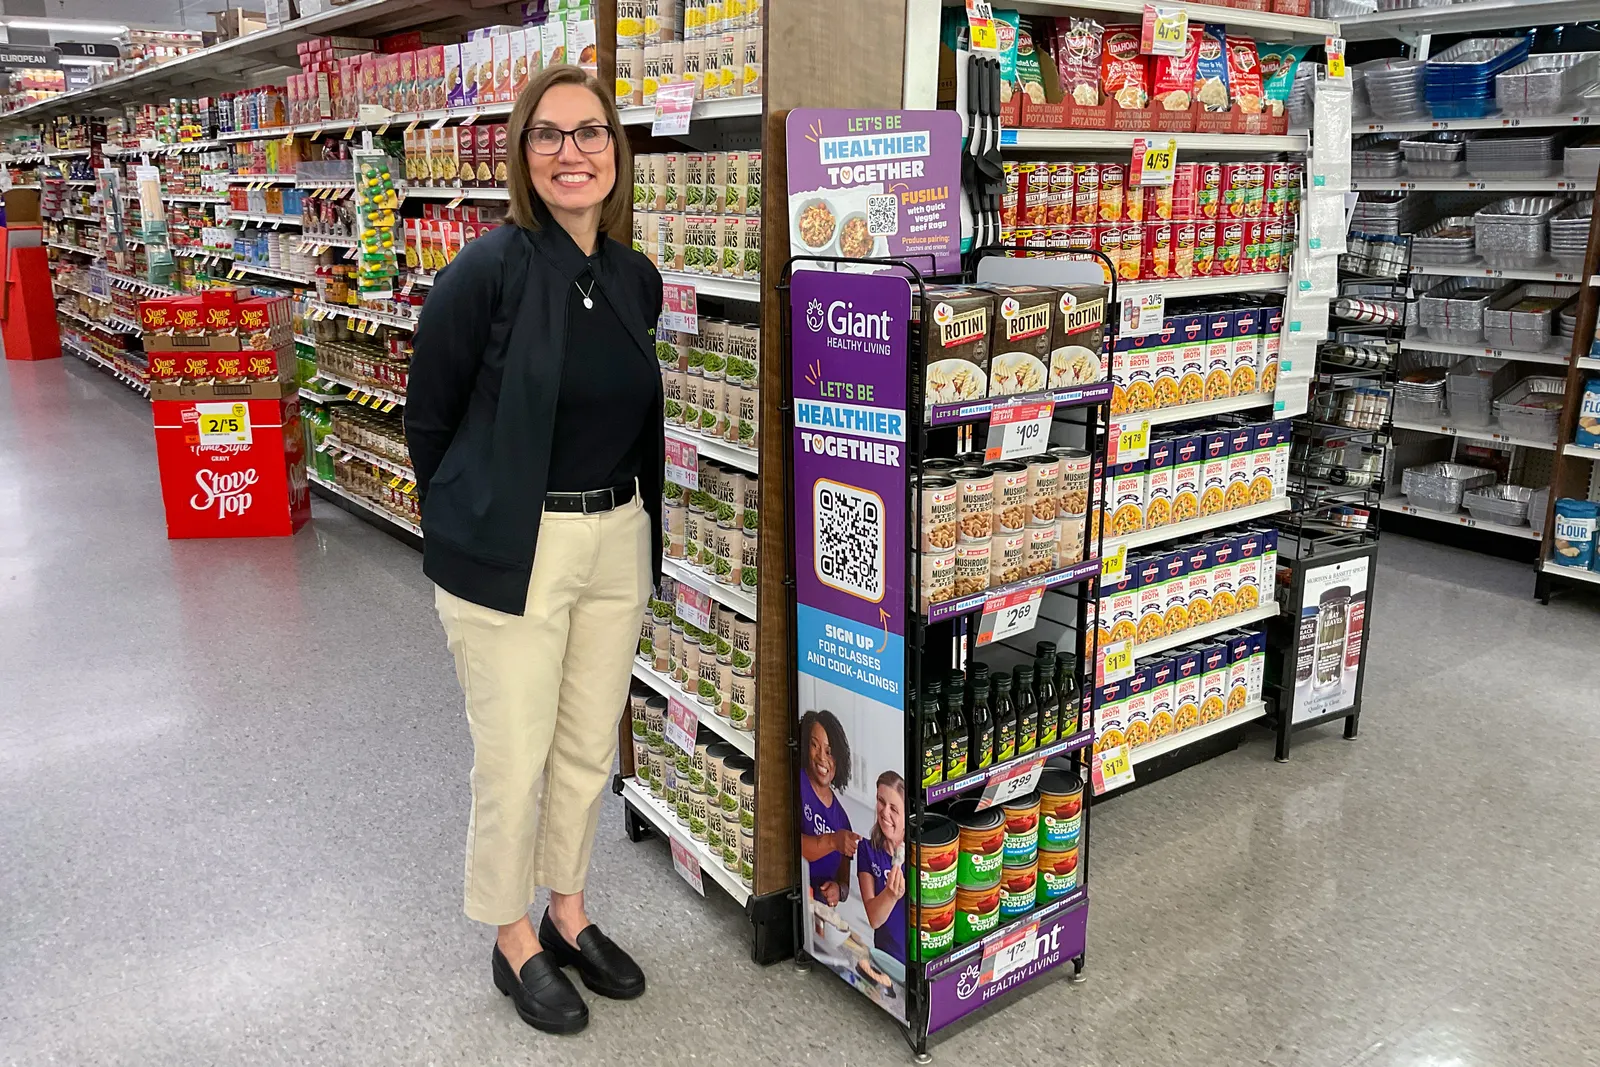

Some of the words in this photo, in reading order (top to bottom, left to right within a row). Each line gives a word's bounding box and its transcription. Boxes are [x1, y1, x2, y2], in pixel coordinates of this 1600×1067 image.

[81, 44, 96, 55] 10
[1110, 42, 1138, 53] IDAHOAN
[1, 54, 47, 64] EUROPEAN
[1027, 105, 1043, 113] 100%
[1071, 108, 1087, 116] 100%
[848, 116, 883, 132] LET'S
[885, 115, 902, 130] BE
[1026, 113, 1063, 123] POTATOES
[1071, 116, 1106, 126] POTATOES
[1114, 119, 1151, 128] POTATOES
[1158, 120, 1191, 129] POTATOES
[1199, 121, 1232, 129] POTATOES
[823, 135, 927, 160] HEALTHIER
[1146, 153, 1170, 170] 4/$5
[828, 160, 925, 186] TOGETHER
[901, 186, 949, 206] FUSILLI
[907, 205, 925, 216] with
[925, 202, 946, 213] Quick
[914, 213, 940, 223] Veggie
[910, 223, 927, 233] Beef
[928, 220, 947, 230] Ragu
[902, 236, 927, 244] Produce
[927, 235, 950, 244] pairing:
[827, 300, 891, 341] Giant
[1068, 305, 1101, 328] ROTINI
[945, 315, 983, 341] ROTINI
[1010, 310, 1047, 335] ROTINI
[705, 339, 724, 353] EANS
[826, 336, 862, 352] HEALTHY
[863, 340, 891, 356] LIVING
[1235, 345, 1253, 353] BROTH
[1183, 351, 1201, 360] BROTH
[1209, 348, 1227, 356] BROTH
[1129, 359, 1150, 367] BROTH
[1156, 355, 1175, 364] BROTH
[819, 380, 854, 400] LET'S
[857, 384, 875, 402] BE
[1083, 388, 1109, 397] TOGETHER
[952, 408, 959, 417] BE
[961, 403, 992, 415] HEALTHIER
[1583, 400, 1600, 415] FLO
[797, 403, 902, 436] HEALTHIER
[1123, 433, 1142, 450] $179
[801, 432, 900, 467] TOGETHER
[1230, 461, 1247, 470] BROTH
[1254, 456, 1271, 465] BROTH
[1177, 471, 1195, 480] BROTH
[1206, 466, 1223, 475] BROTH
[1151, 476, 1168, 485] BROTH
[190, 468, 259, 511] Stove
[1118, 483, 1138, 492] BROTH
[216, 491, 252, 520] Top
[1556, 522, 1587, 538] FLOUR
[1046, 571, 1073, 584] HEALTHIER
[1074, 564, 1099, 576] TOGETHER
[1239, 566, 1256, 575] BROTH
[1306, 575, 1328, 585] MORTON
[1333, 569, 1352, 578] BASSETT
[1352, 565, 1366, 574] SPICES
[1214, 572, 1232, 581] BROTH
[1189, 578, 1208, 587] BROTH
[1166, 585, 1184, 595] BROTH
[1141, 592, 1160, 602] BROTH
[948, 605, 956, 613] BE
[1113, 599, 1133, 609] BROTH
[1324, 617, 1343, 628] LEAVES
[825, 624, 854, 645] SIGN
[855, 633, 875, 651] UP
[818, 638, 837, 657] FOR
[838, 645, 882, 671] CLASSES
[1108, 654, 1126, 670] $179
[807, 650, 827, 668] AND
[827, 659, 899, 695] COOK-ALONGS!
[1232, 667, 1245, 676] BROTH
[1204, 677, 1221, 686] BROTH
[1178, 685, 1195, 694] BROTH
[1153, 692, 1169, 701] BROTH
[1128, 701, 1146, 710] BROTH
[1102, 709, 1120, 719] BROTH
[1067, 734, 1092, 747] TOGETHER
[1105, 760, 1124, 775] $179
[955, 774, 985, 789] HEALTHIER
[1060, 891, 1083, 906] TOGETHER
[951, 942, 979, 959] HEALTHIER
[982, 968, 1028, 1000] HEALTHY
[1028, 951, 1060, 975] LIVING
